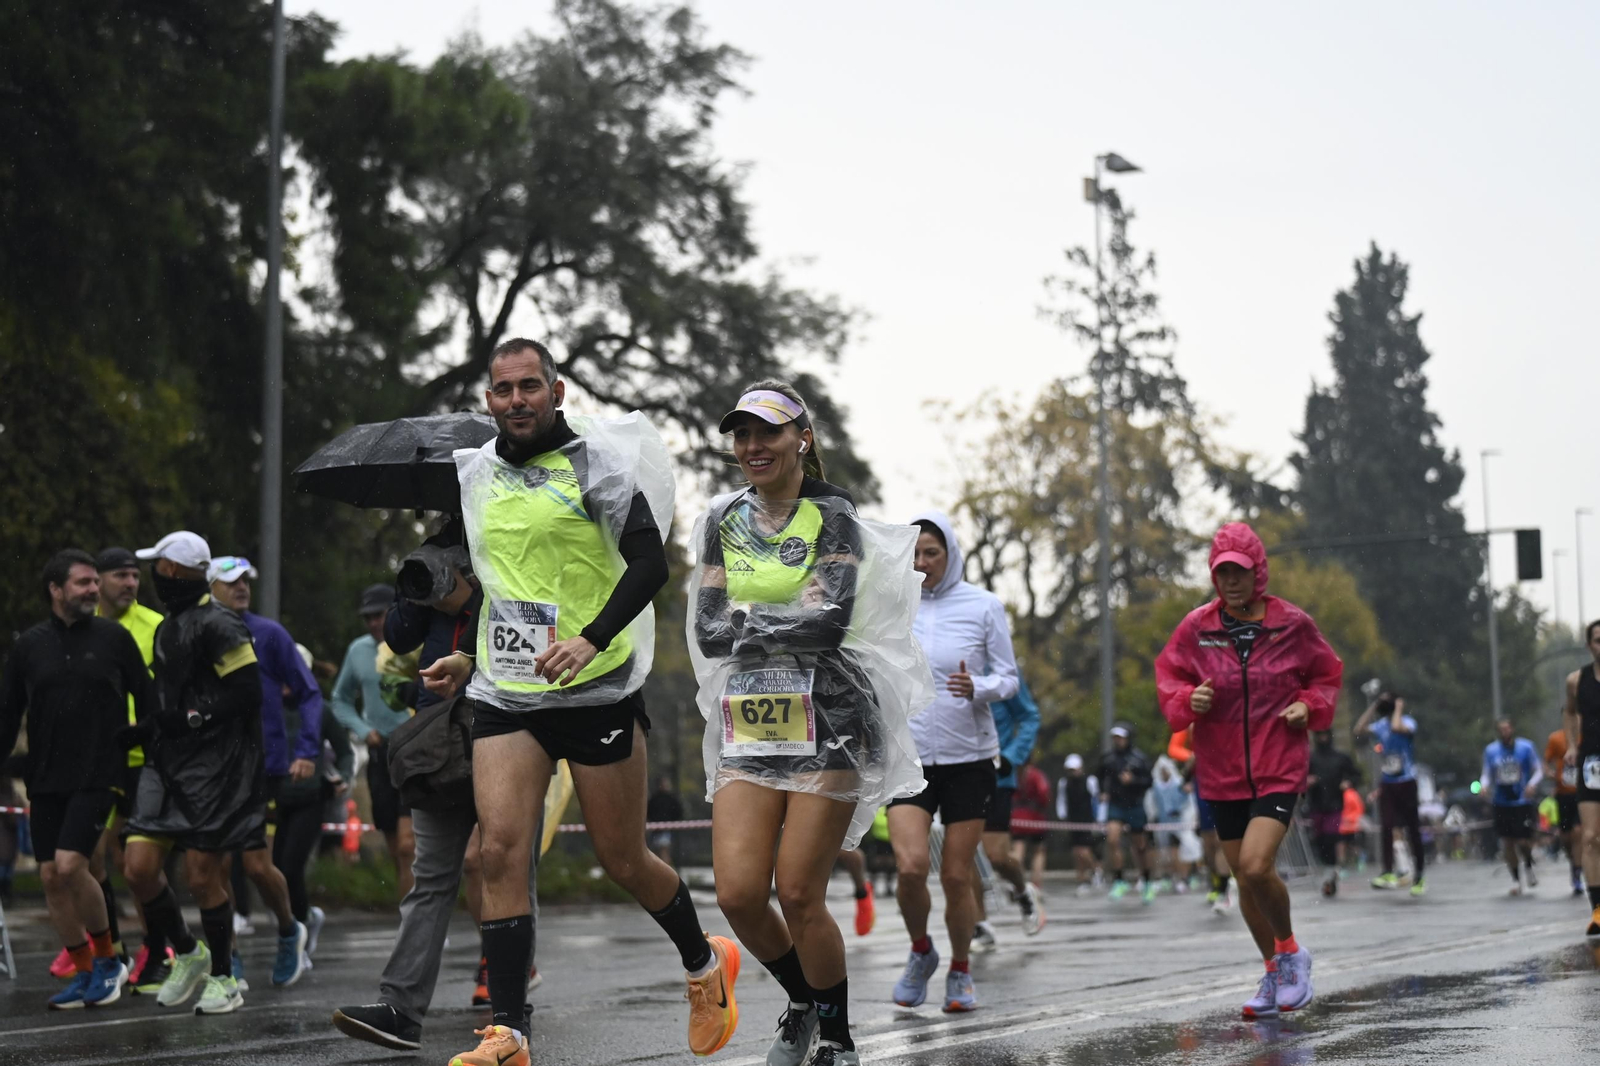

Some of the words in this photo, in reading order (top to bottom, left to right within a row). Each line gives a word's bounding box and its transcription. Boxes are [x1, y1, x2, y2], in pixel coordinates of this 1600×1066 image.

[495, 657, 515, 665] ANTONIO
[764, 671, 792, 679] MEDIA
[741, 699, 791, 724] 627
